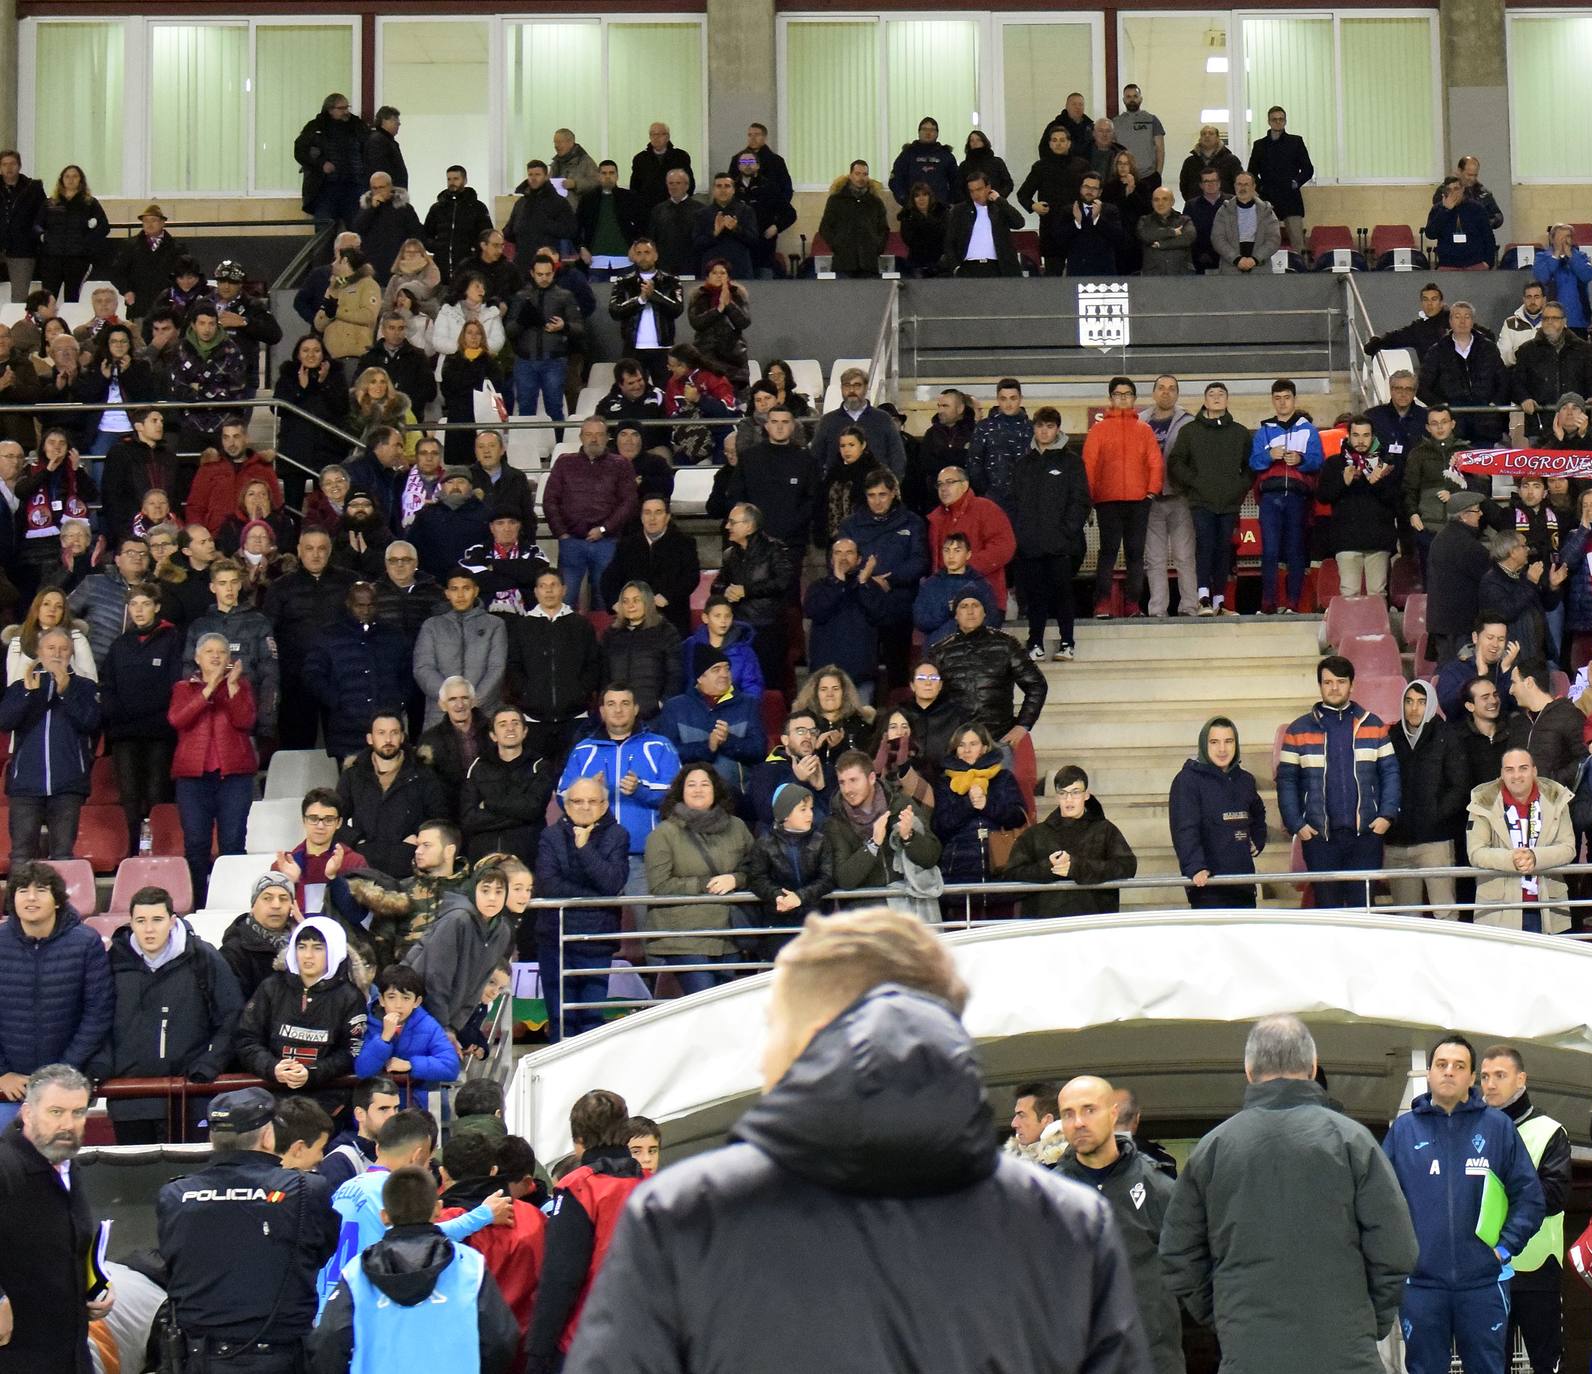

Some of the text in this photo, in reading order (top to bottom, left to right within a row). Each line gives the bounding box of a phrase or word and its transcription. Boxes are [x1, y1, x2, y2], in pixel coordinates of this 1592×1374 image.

[1466, 453, 1498, 466] S.D.
[1429, 1159, 1441, 1175] A
[182, 1187, 268, 1203] POLICIA
